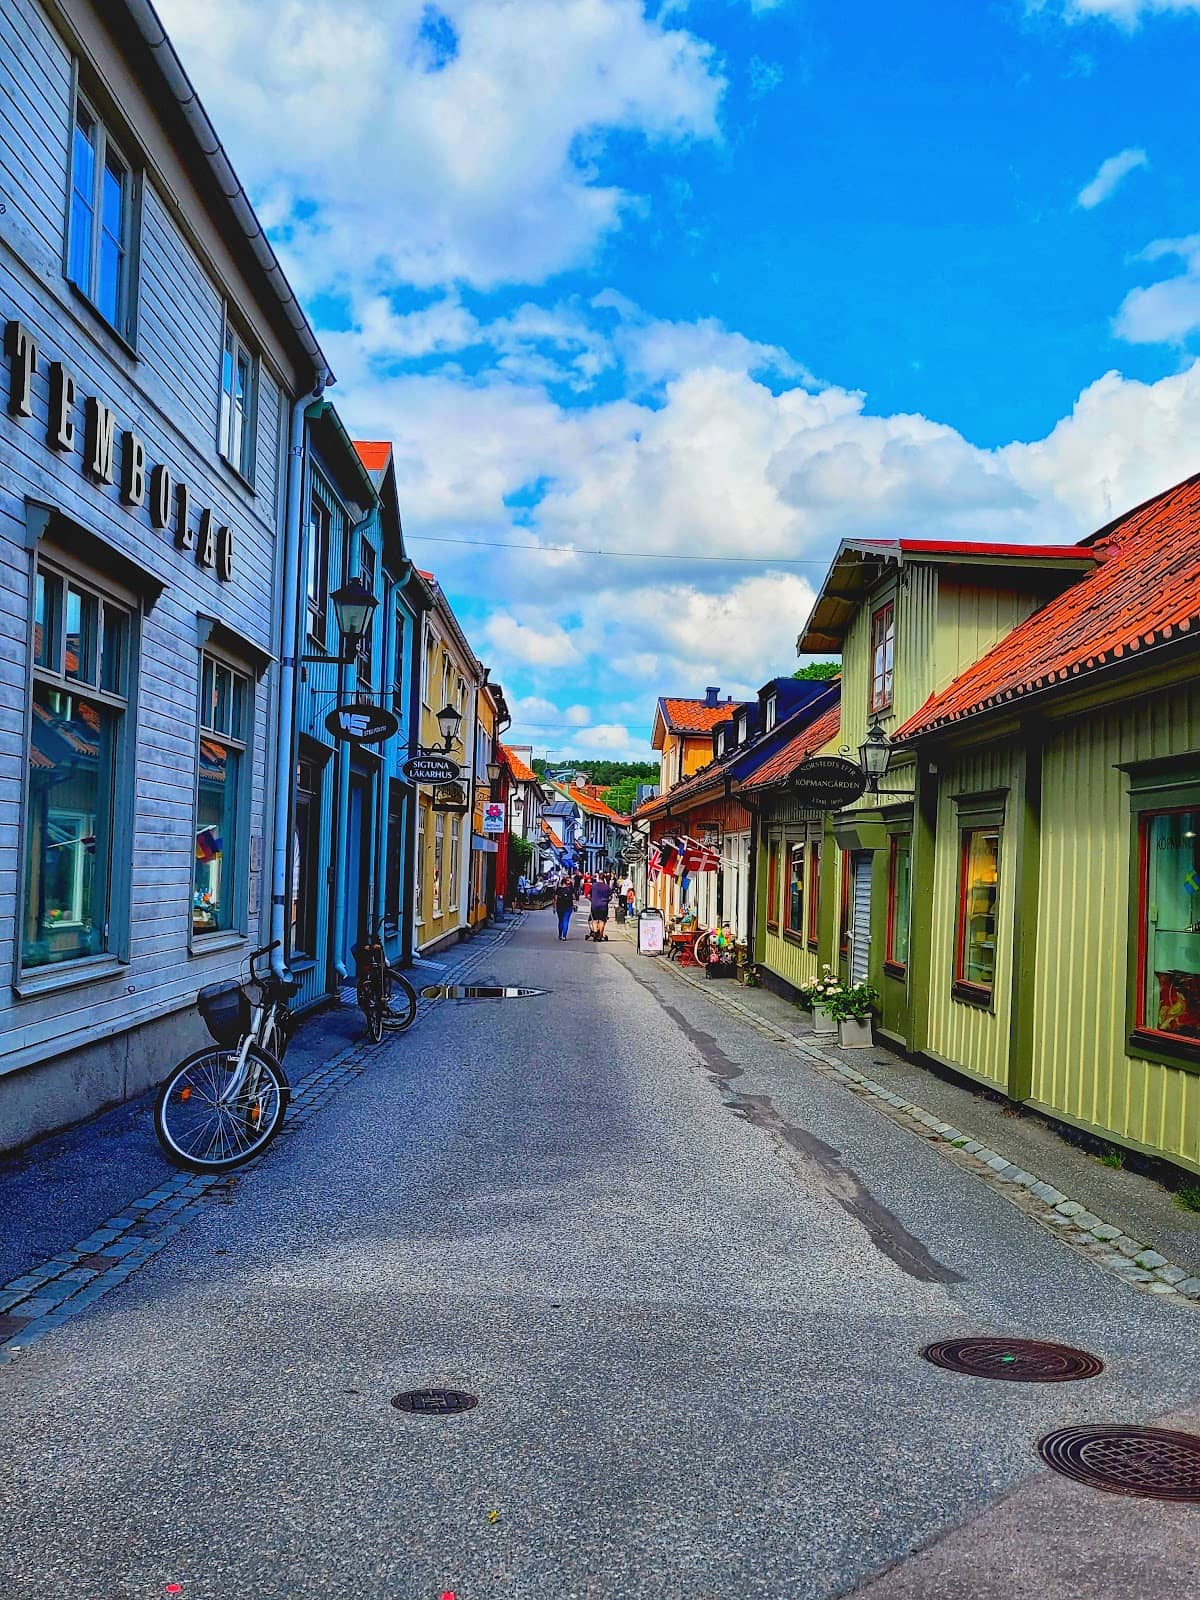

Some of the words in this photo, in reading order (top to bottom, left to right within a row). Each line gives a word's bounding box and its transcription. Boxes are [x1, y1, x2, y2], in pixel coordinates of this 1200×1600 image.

[4, 320, 235, 583] TEMBOLAG
[413, 760, 449, 770] SIGTUNA
[409, 768, 453, 779] LÄKARHUS
